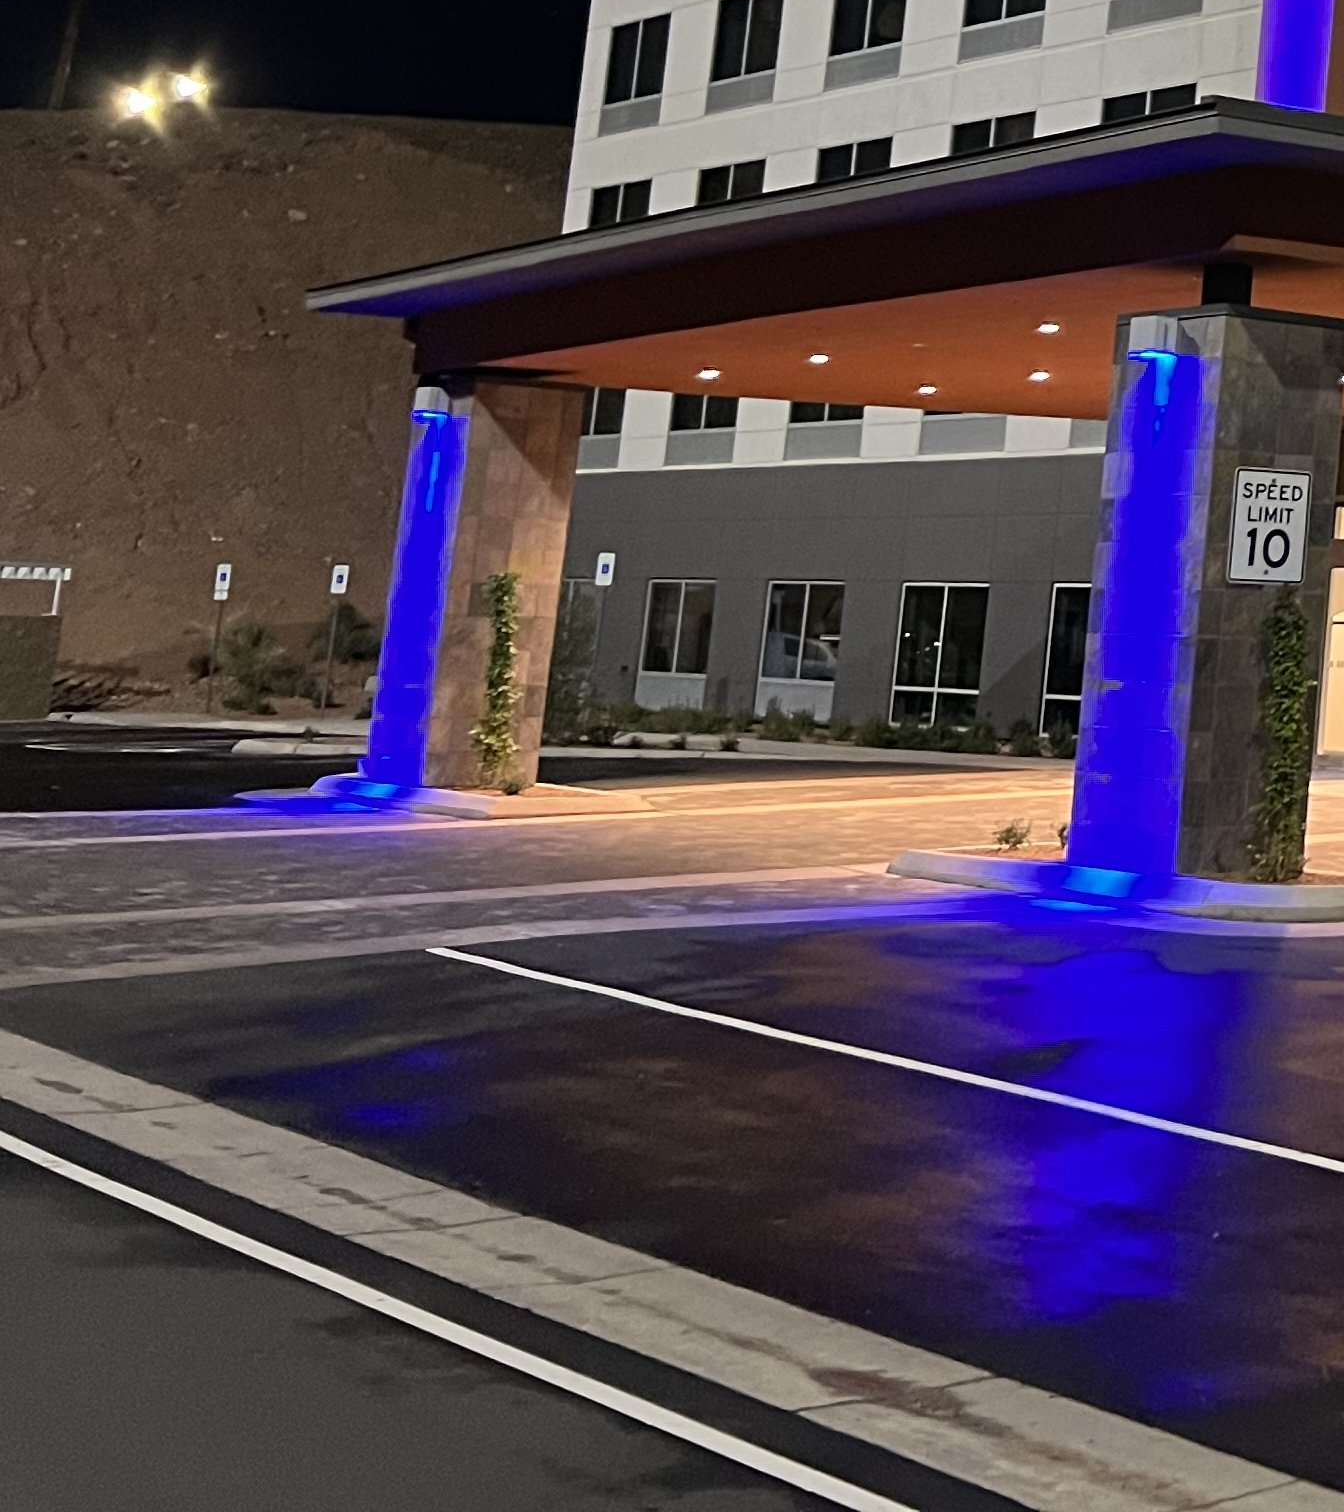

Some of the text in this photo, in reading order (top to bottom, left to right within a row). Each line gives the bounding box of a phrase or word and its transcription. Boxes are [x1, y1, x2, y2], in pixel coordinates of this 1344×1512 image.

[1242, 482, 1304, 502] SPEED
[1247, 505, 1295, 524] LIMIT
[1246, 527, 1291, 569] 10
